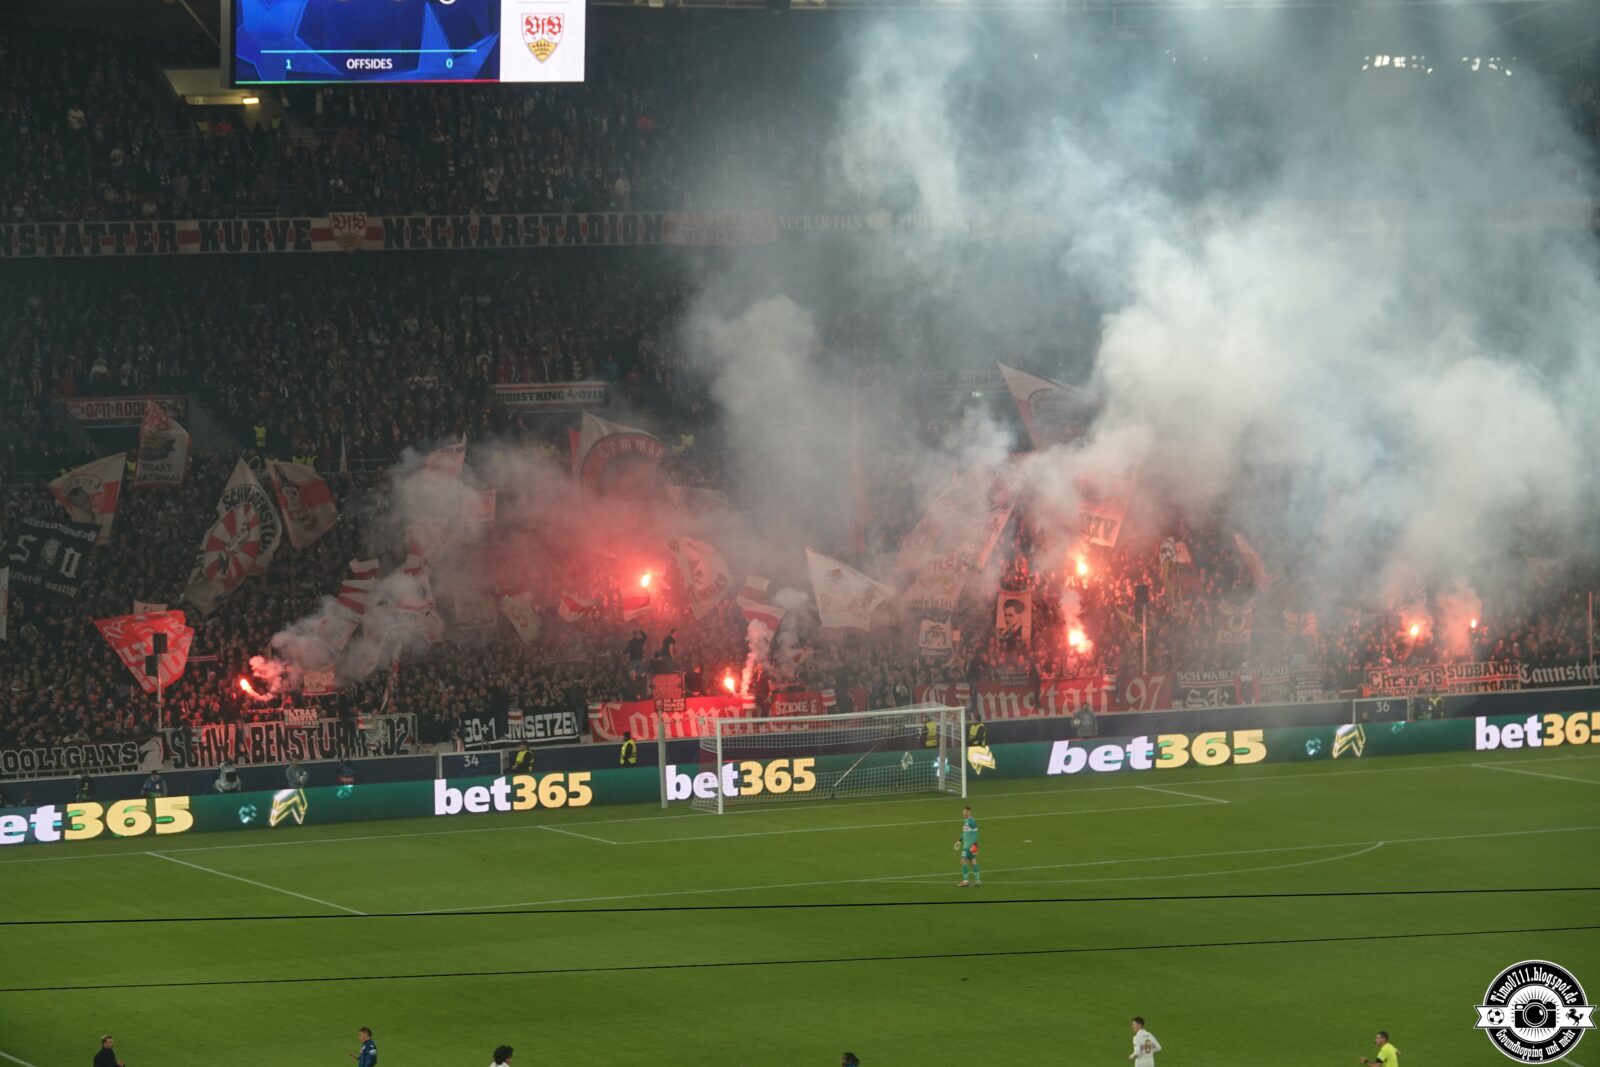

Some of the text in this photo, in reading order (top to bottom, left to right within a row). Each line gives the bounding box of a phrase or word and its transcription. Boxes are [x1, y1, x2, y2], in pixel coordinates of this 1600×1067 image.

[285, 58, 453, 70] 1 OFFSIDES 0
[199, 219, 312, 252] KURVE
[383, 212, 664, 250] NECKARSTADION
[1421, 668, 1444, 686] 36
[1448, 679, 1520, 694] STUTTGART
[921, 675, 1167, 721] Cnnstatt 97
[1376, 701, 1390, 713] 36
[463, 754, 480, 768] 34
[1047, 728, 1267, 775] bet365
[434, 772, 593, 816] bet365
[664, 757, 817, 801] bet365
[0, 796, 194, 845] et365
